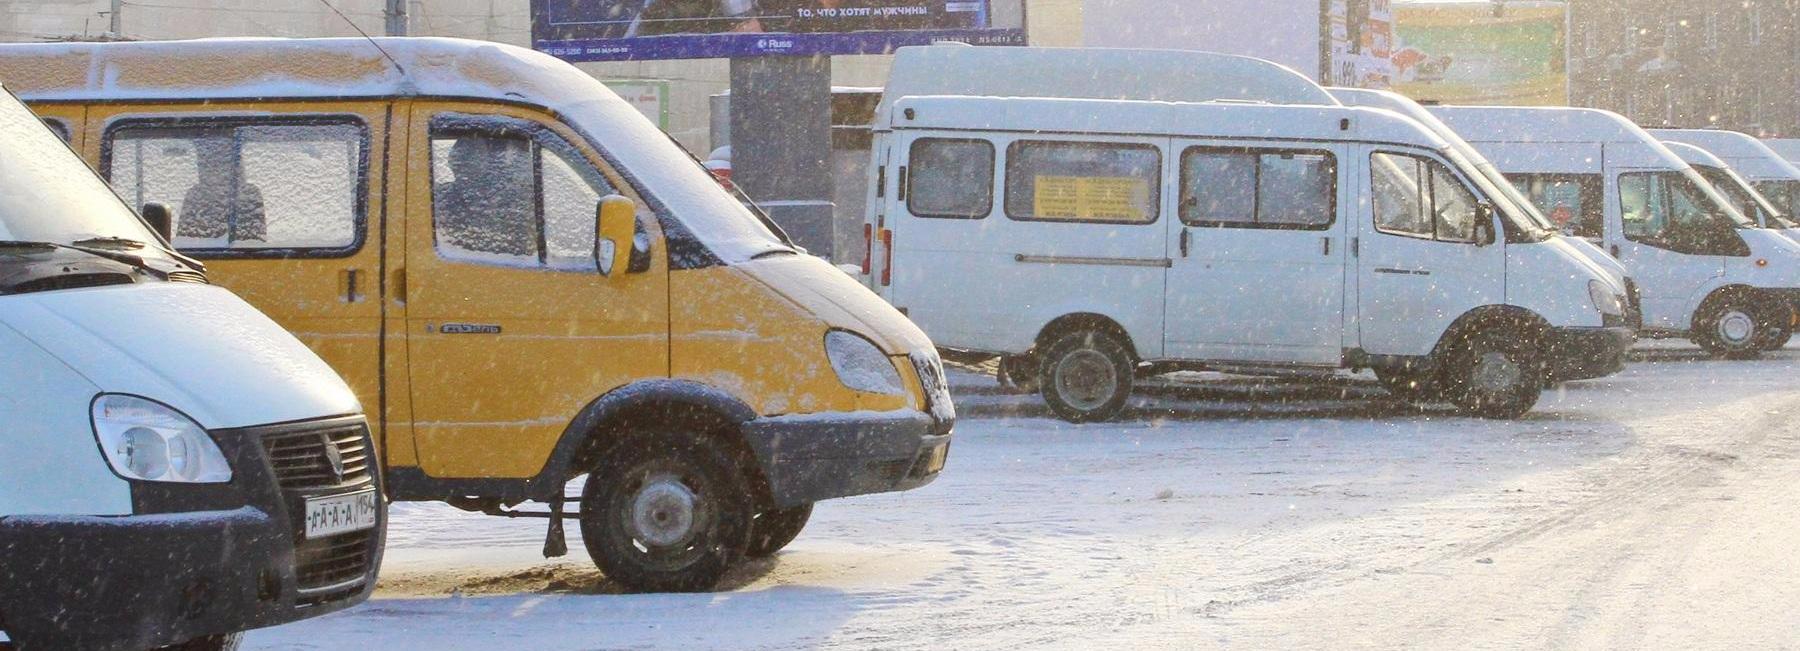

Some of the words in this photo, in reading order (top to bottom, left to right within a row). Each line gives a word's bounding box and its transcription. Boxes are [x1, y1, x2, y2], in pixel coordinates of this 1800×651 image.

[816, 8, 836, 16] ЧТО
[840, 8, 870, 16] ХОТЯТ
[873, 6, 927, 15] МУЖЧИНЫ
[768, 39, 793, 48] Russ
